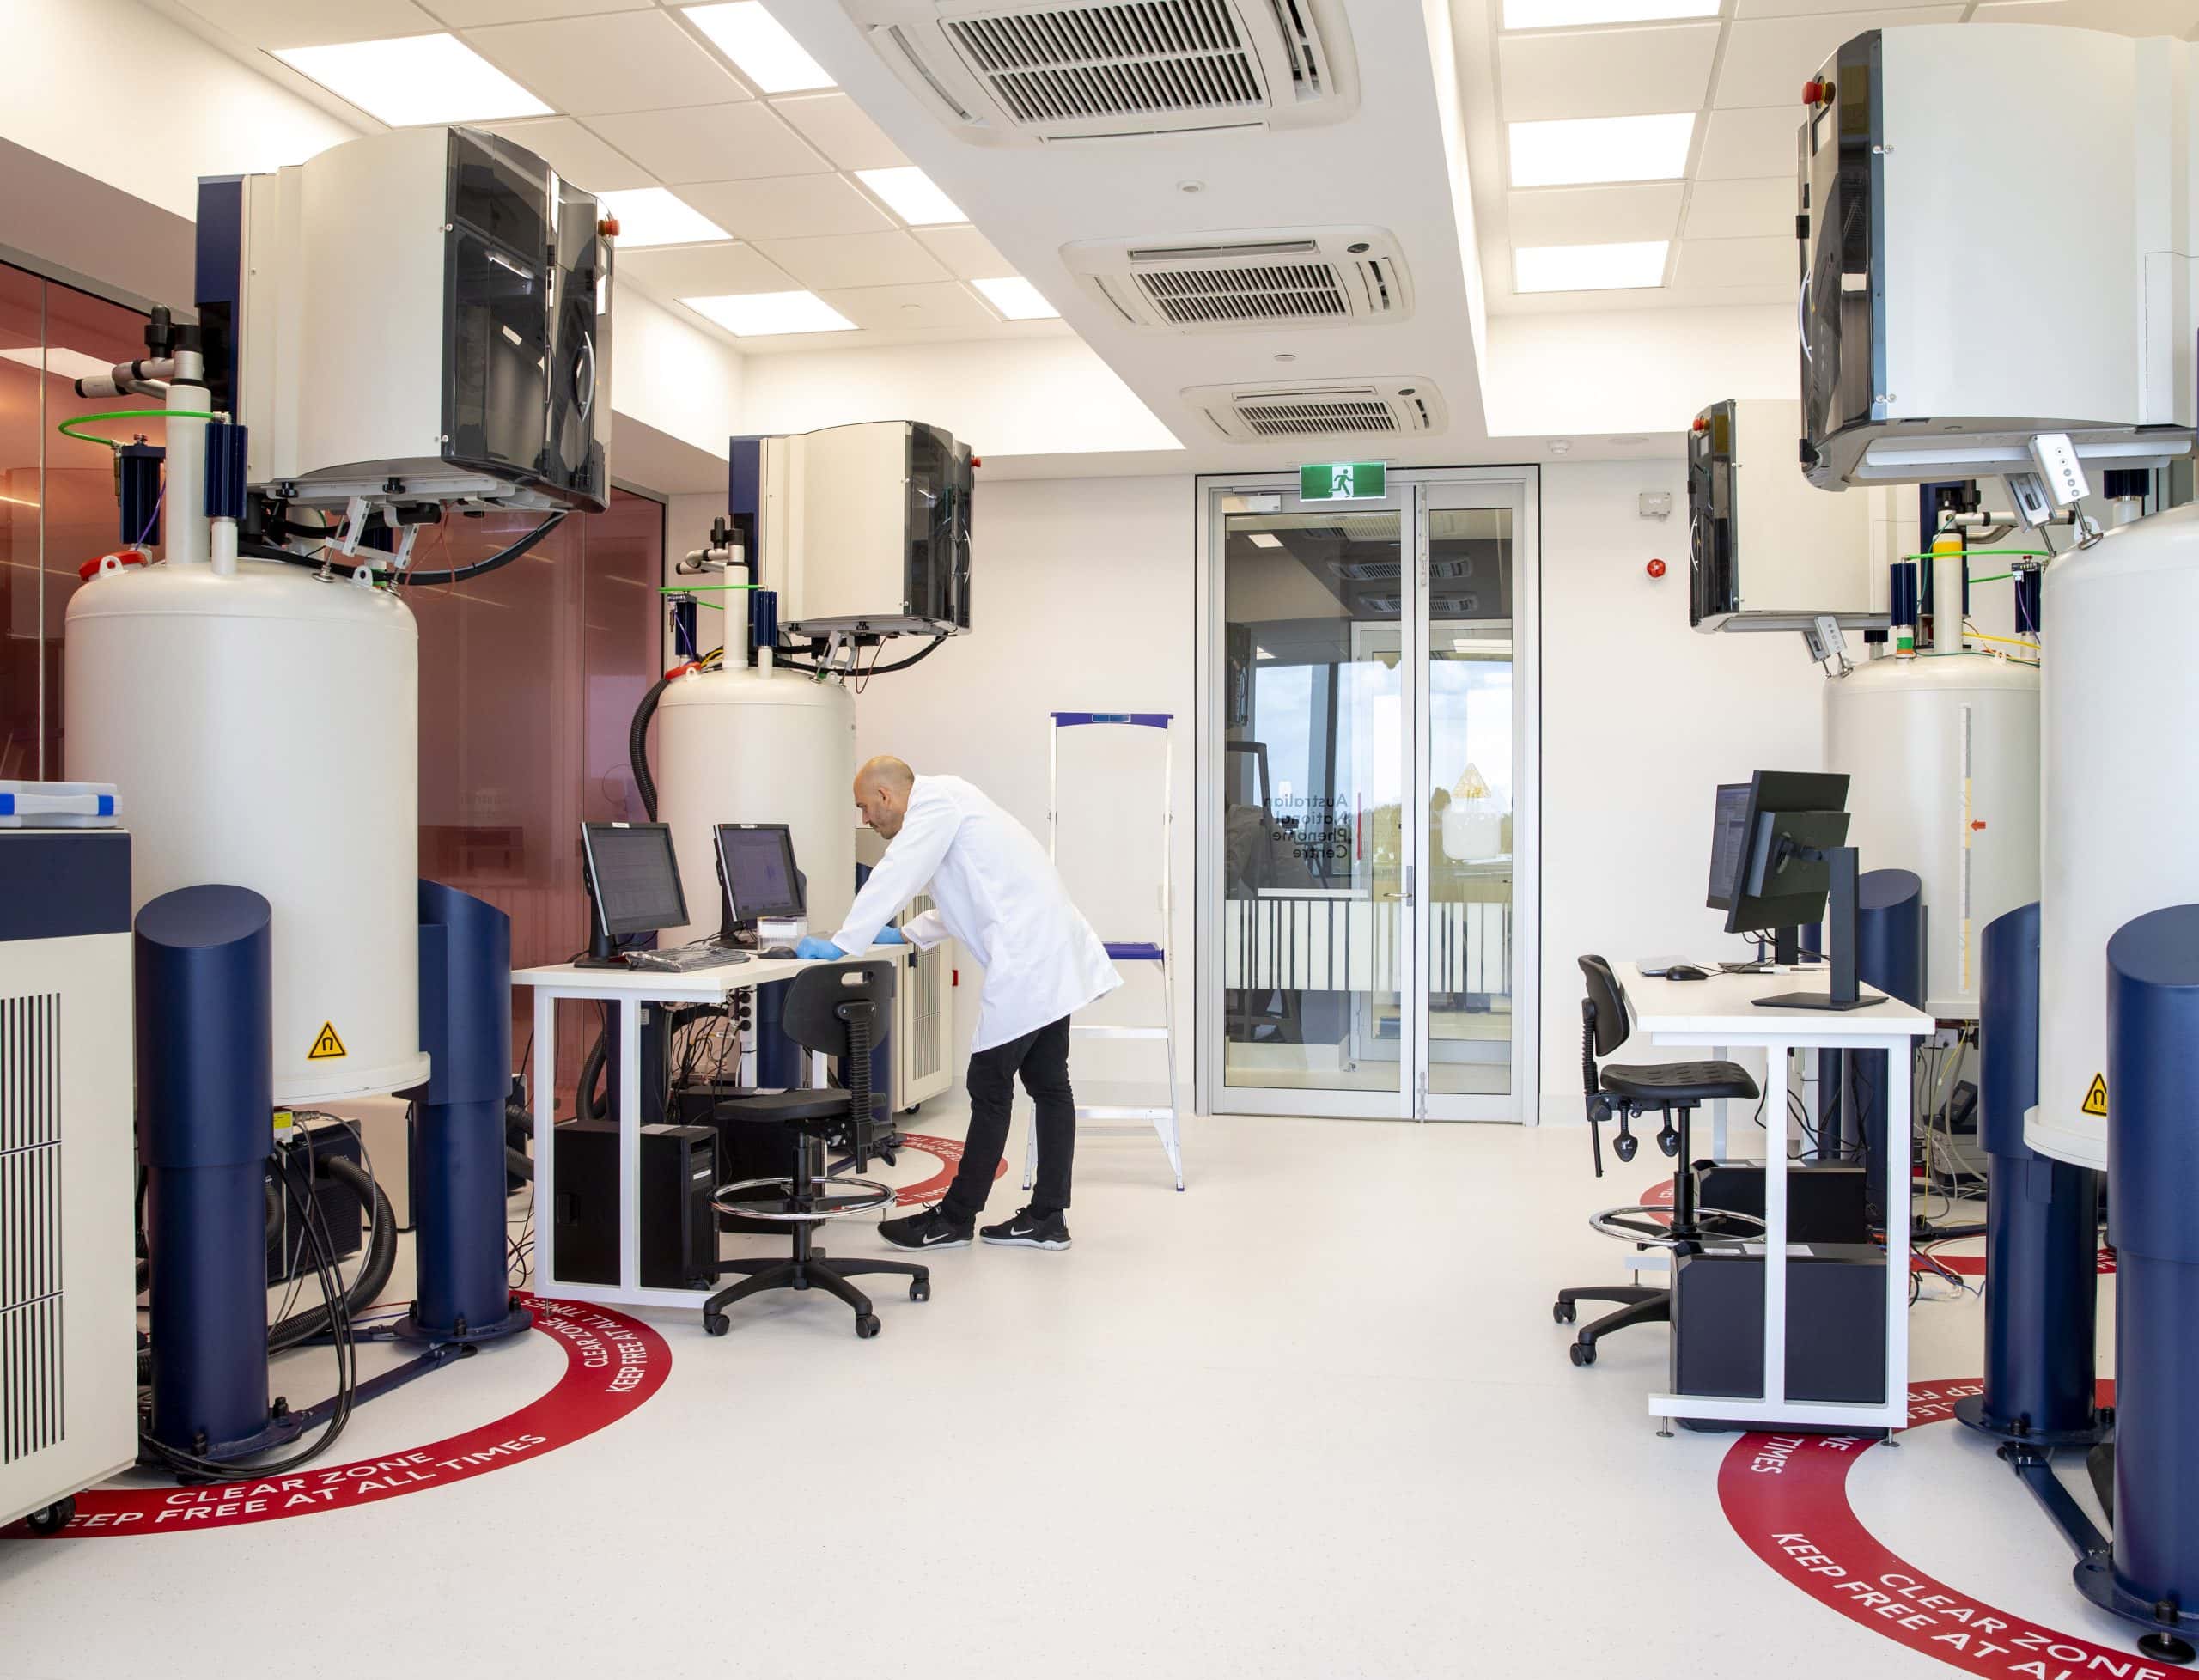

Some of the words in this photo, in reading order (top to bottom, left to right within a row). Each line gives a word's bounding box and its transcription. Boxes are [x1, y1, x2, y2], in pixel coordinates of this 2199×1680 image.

[539, 1318, 593, 1340] ZONE
[582, 1314, 623, 1329] ALL
[605, 1330, 640, 1340] AT
[576, 1338, 609, 1367] CLEAR
[617, 1341, 647, 1365] FREE
[605, 1367, 645, 1392] KEEP
[1751, 1436, 1805, 1475] TIMES
[66, 1512, 143, 1527] EEP
[155, 1499, 268, 1523] FREE
[284, 1488, 343, 1507] AT
[357, 1470, 436, 1494] ALL
[436, 1433, 547, 1471] TIMES
[166, 1478, 305, 1505] CLEAR
[318, 1452, 435, 1485] ZONE
[1771, 1533, 1847, 1577] KEEP
[1832, 1581, 1939, 1630] FREE
[1931, 1633, 2011, 1658] AT
[1879, 1573, 2007, 1635] CLEAR
[2009, 1632, 2166, 1680] ZONE
